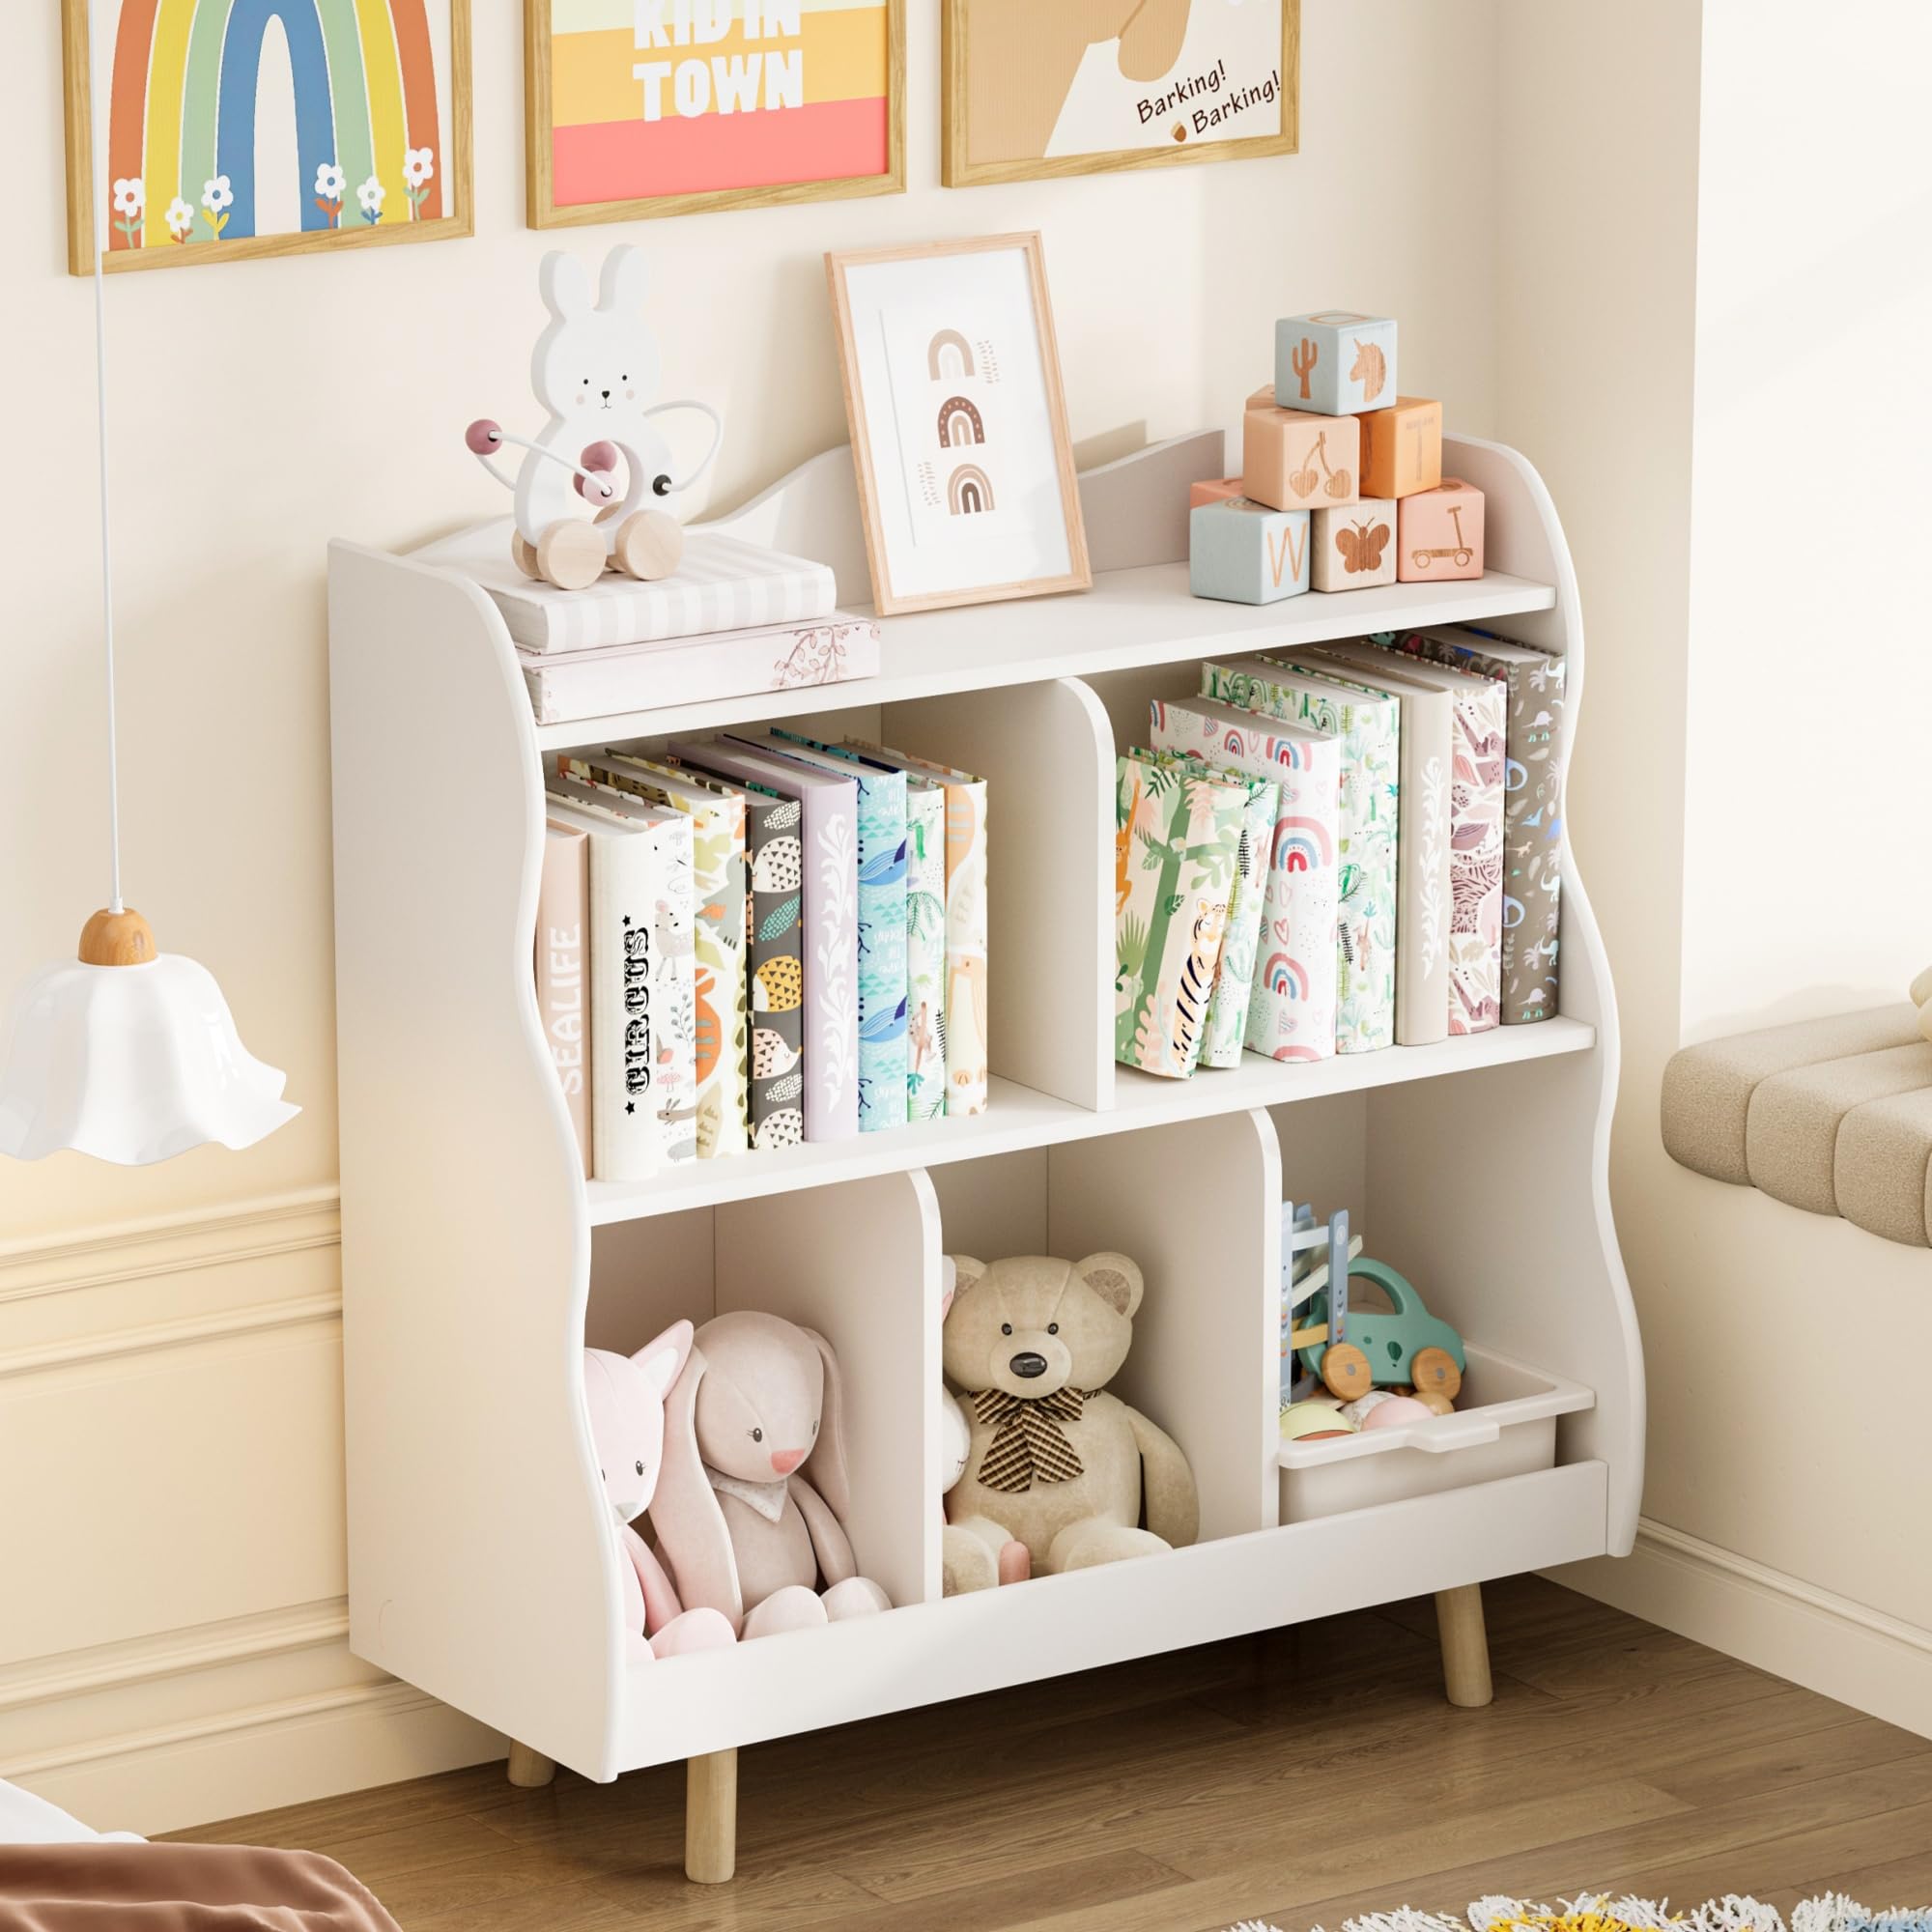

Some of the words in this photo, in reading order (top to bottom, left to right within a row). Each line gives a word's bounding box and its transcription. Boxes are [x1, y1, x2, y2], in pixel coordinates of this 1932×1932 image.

[634, 0, 732, 49] KID
[743, 0, 801, 40] IN
[633, 50, 803, 122] TOWN
[1137, 59, 1226, 124] Barking!
[1192, 70, 1280, 134] Barking!
[1406, 416, 1435, 482] T
[1267, 522, 1307, 587] W
[623, 926, 650, 1095] CIRCUS
